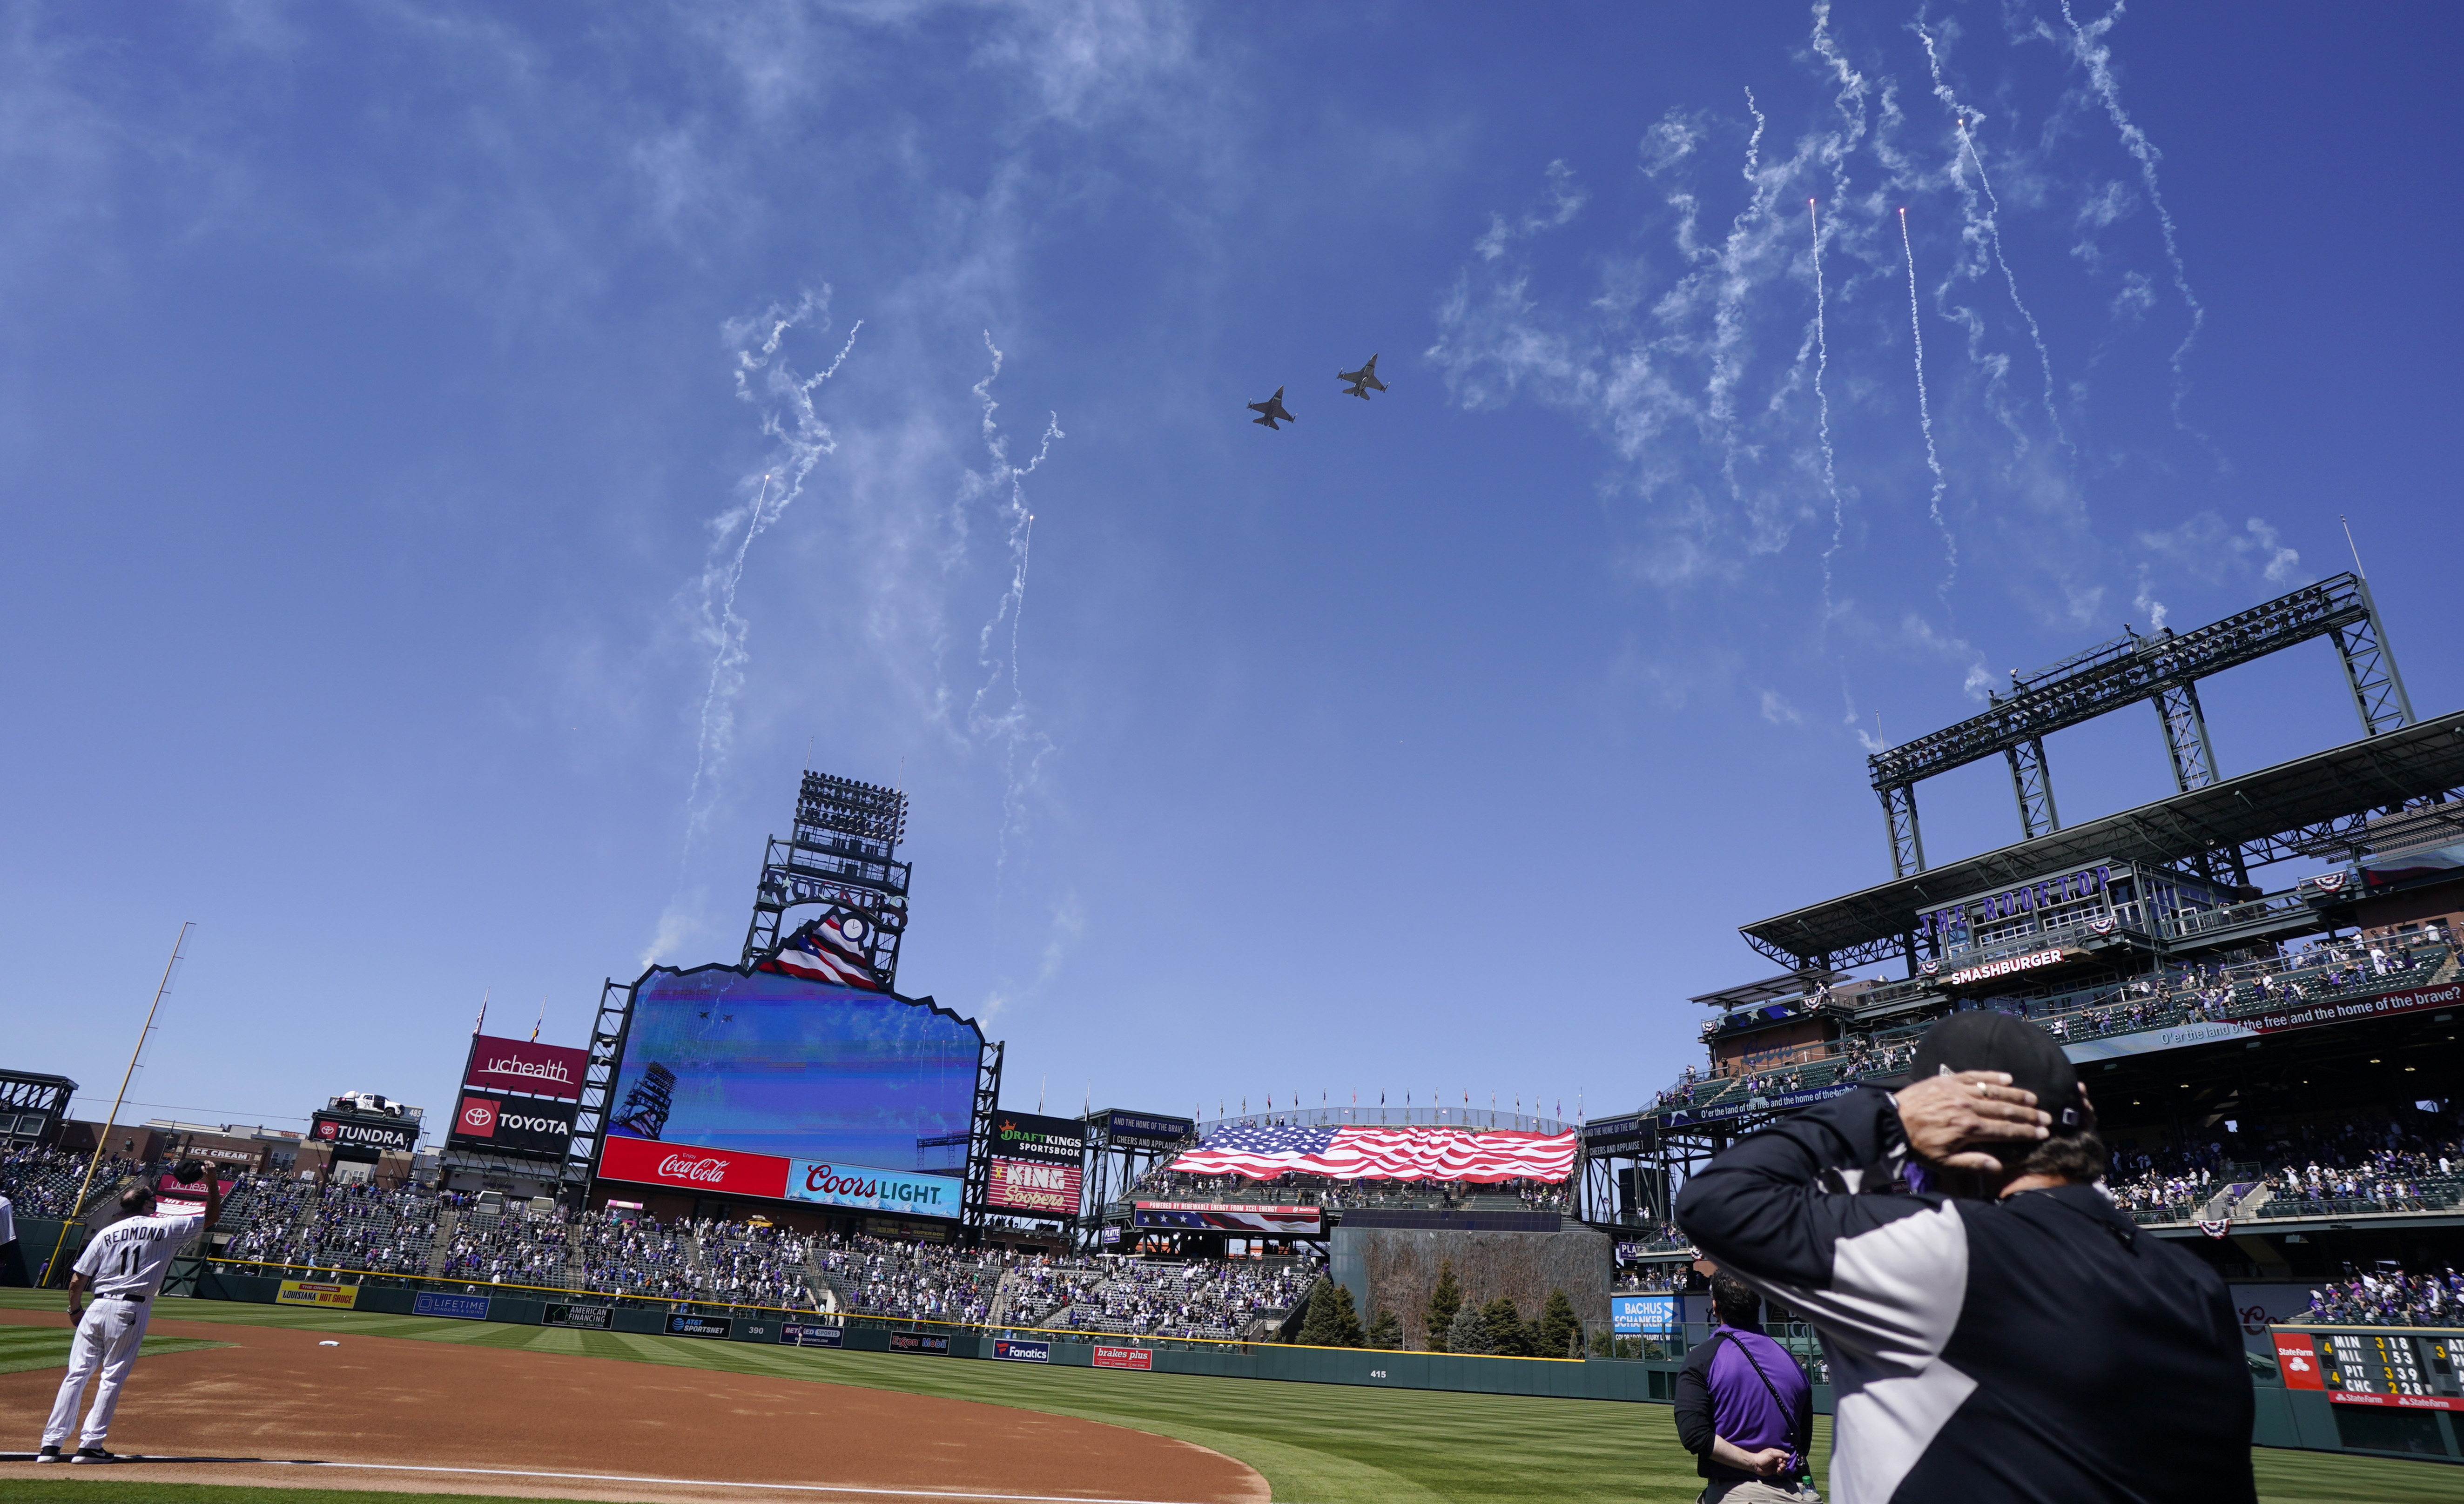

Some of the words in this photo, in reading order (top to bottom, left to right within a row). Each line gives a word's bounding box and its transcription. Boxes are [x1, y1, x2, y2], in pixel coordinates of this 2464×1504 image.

[758, 869, 909, 929] ROCKIES
[1919, 904, 1967, 936] THE
[1983, 866, 2111, 921] ROOFTOP
[1952, 949, 2064, 986] SMASHBURGER
[2161, 1033, 2184, 1044] O'er
[2186, 1028, 2203, 1040] the
[2206, 1024, 2229, 1037] land
[2230, 1021, 2242, 1033] of
[2243, 1019, 2262, 1030] the
[2264, 1015, 2287, 1027] free
[2290, 1010, 2313, 1024] and
[2315, 1006, 2335, 1020] the
[2336, 1003, 2373, 1016] home
[2376, 997, 2388, 1010] of
[2390, 996, 2413, 1008] the
[2414, 986, 2461, 1005] brave?
[488, 1054, 568, 1081] uchealth
[1701, 1109, 1714, 1118] O'er
[1715, 1108, 1724, 1116] the
[1725, 1105, 1738, 1114] land
[1739, 1102, 1746, 1112] of
[1746, 1101, 1757, 1111] the
[1757, 1100, 1769, 1109] free
[1771, 1097, 1782, 1108] and
[1784, 1096, 1794, 1105] the
[1795, 1093, 1813, 1104] home
[1815, 1090, 1821, 1100] of
[1823, 1090, 1833, 1099] the
[409, 1108, 421, 1117] 485
[499, 1113, 568, 1135] TOYOTA
[1114, 1117, 1124, 1126] AND
[1126, 1119, 1134, 1127] THE
[1136, 1121, 1150, 1129] HOME
[1158, 1123, 1167, 1131] THE
[1168, 1124, 1184, 1134] BRAVE
[1602, 1125, 1614, 1135] HOME
[1615, 1124, 1619, 1133] OF
[338, 1125, 404, 1145] TUNDRA
[1001, 1129, 1082, 1148] DRAFTKINGS
[1117, 1135, 1138, 1145] CHEERS
[1138, 1138, 1150, 1147] AND
[1151, 1140, 1177, 1149] APPLAUS
[211, 1150, 247, 1159] CREAM
[1019, 1142, 1080, 1157] SPORTSBOOK
[1589, 1146, 1606, 1156] CHEERS
[1607, 1144, 1616, 1154] AND
[1617, 1141, 1640, 1152] APPLAUSE
[658, 1154, 731, 1182] Coca-Cola
[806, 1164, 877, 1198] Coors
[880, 1181, 942, 1204] LIGHT
[1006, 1165, 1065, 1189] KING
[1003, 1185, 1064, 1209] Soopers
[104, 1227, 165, 1246] REDMOND
[1105, 1229, 1119, 1237] PLATTE
[120, 1245, 141, 1276] 11
[319, 1293, 332, 1302] HOT
[332, 1294, 353, 1303] SAUCE
[434, 1299, 485, 1310] LIFETIME
[570, 1306, 607, 1316] AMERICAN
[1625, 1303, 1662, 1314] BACHUS
[568, 1313, 605, 1323] FINANCING
[1615, 1315, 1663, 1327] SCHANKER
[684, 1325, 724, 1334] SPORTSNET
[892, 1336, 918, 1349] Exxon
[922, 1338, 947, 1349] Mobil
[2324, 1342, 2332, 1354] 4
[2334, 1336, 2361, 1349] MIN
[2375, 1336, 2384, 1349] 3
[1009, 1345, 1047, 1359] Fanatics
[1097, 1348, 1127, 1358] brakes
[1128, 1350, 1148, 1360] plus
[2338, 1350, 2363, 1363] MIL
[2380, 1351, 2388, 1363] 1
[2435, 1345, 2446, 1358] 3
[2332, 1371, 2340, 1383] 4
[2344, 1365, 2364, 1378] PIT
[2383, 1367, 2394, 1379] 3
[2345, 1379, 2374, 1393] CHC
[2388, 1382, 2398, 1394] 2
